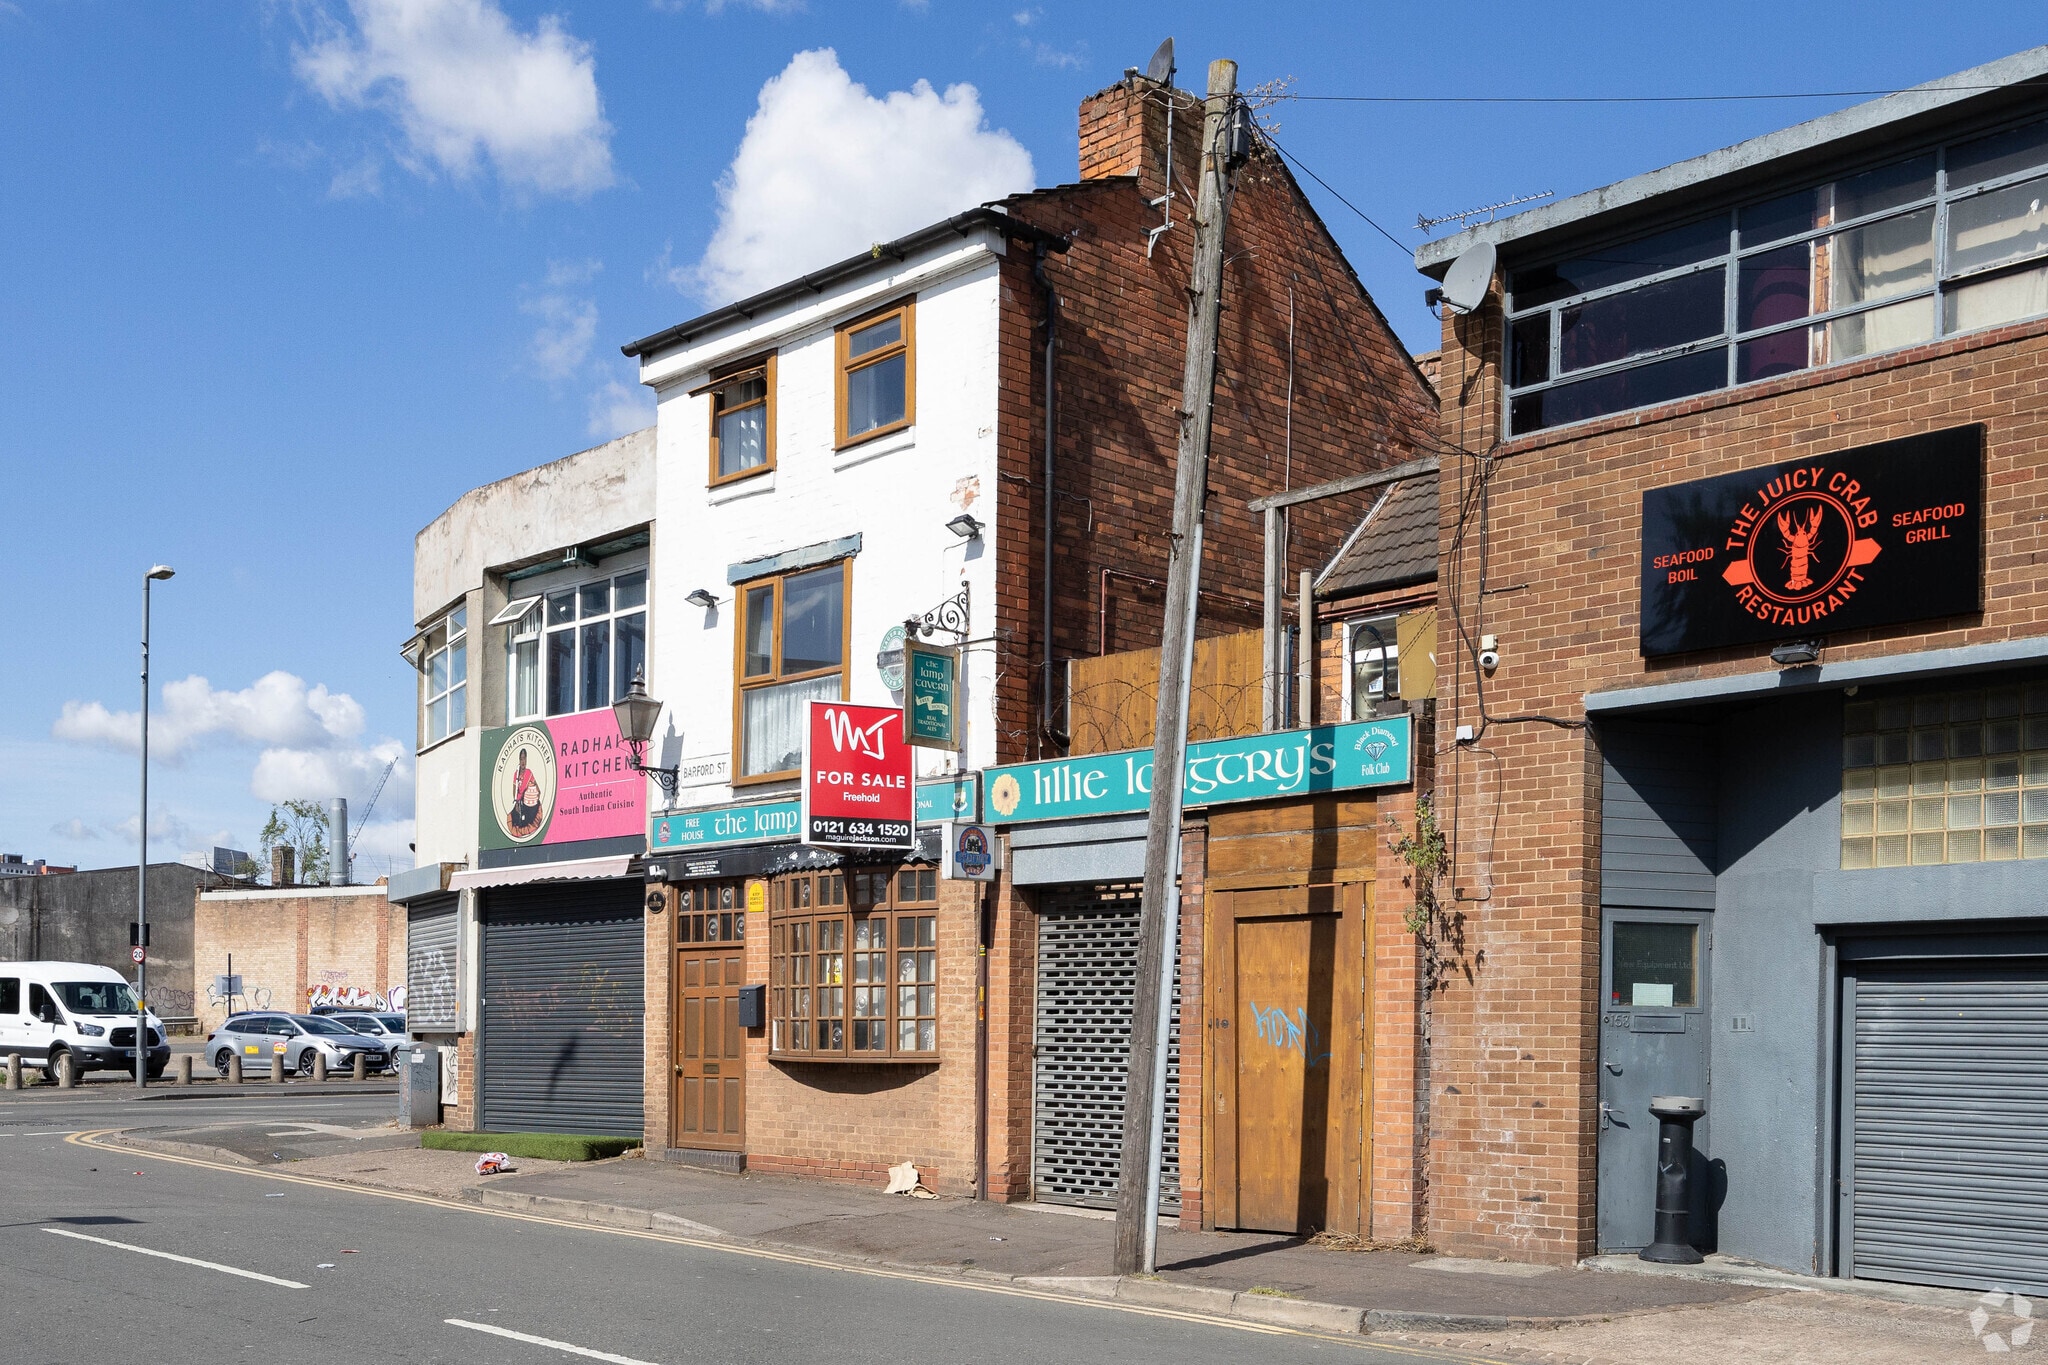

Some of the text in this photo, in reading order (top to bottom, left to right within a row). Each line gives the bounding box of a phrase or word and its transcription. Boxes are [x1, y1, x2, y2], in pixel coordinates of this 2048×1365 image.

[1726, 467, 1878, 550] THE JUICY CRAB
[1892, 503, 1965, 528] SEAFOOD
[1905, 525, 1951, 544] GRILL
[1653, 547, 1714, 569] SEAFOOD
[1667, 568, 1699, 585] BOIL
[1735, 567, 1865, 626] RESTAURANT
[917, 719, 946, 728] TRADITIONAL
[1353, 726, 1399, 751] Black Diamond
[526, 733, 551, 764] KITCHEN
[565, 756, 633, 778] KITCHEN
[684, 762, 727, 779] BARFORD ST
[1361, 762, 1390, 776] Folk Club
[816, 770, 906, 789] FOR SALE
[579, 789, 613, 801] Authentic
[843, 791, 880, 803] Freehold
[559, 800, 635, 817] South Indian Cuisine
[685, 817, 700, 829] FREE
[754, 809, 798, 834] lamp
[813, 820, 909, 836] 0121 634 1520
[681, 829, 704, 841] HOUSE
[825, 834, 897, 844] maguirejackson.com
[134, 951, 143, 959] 20
